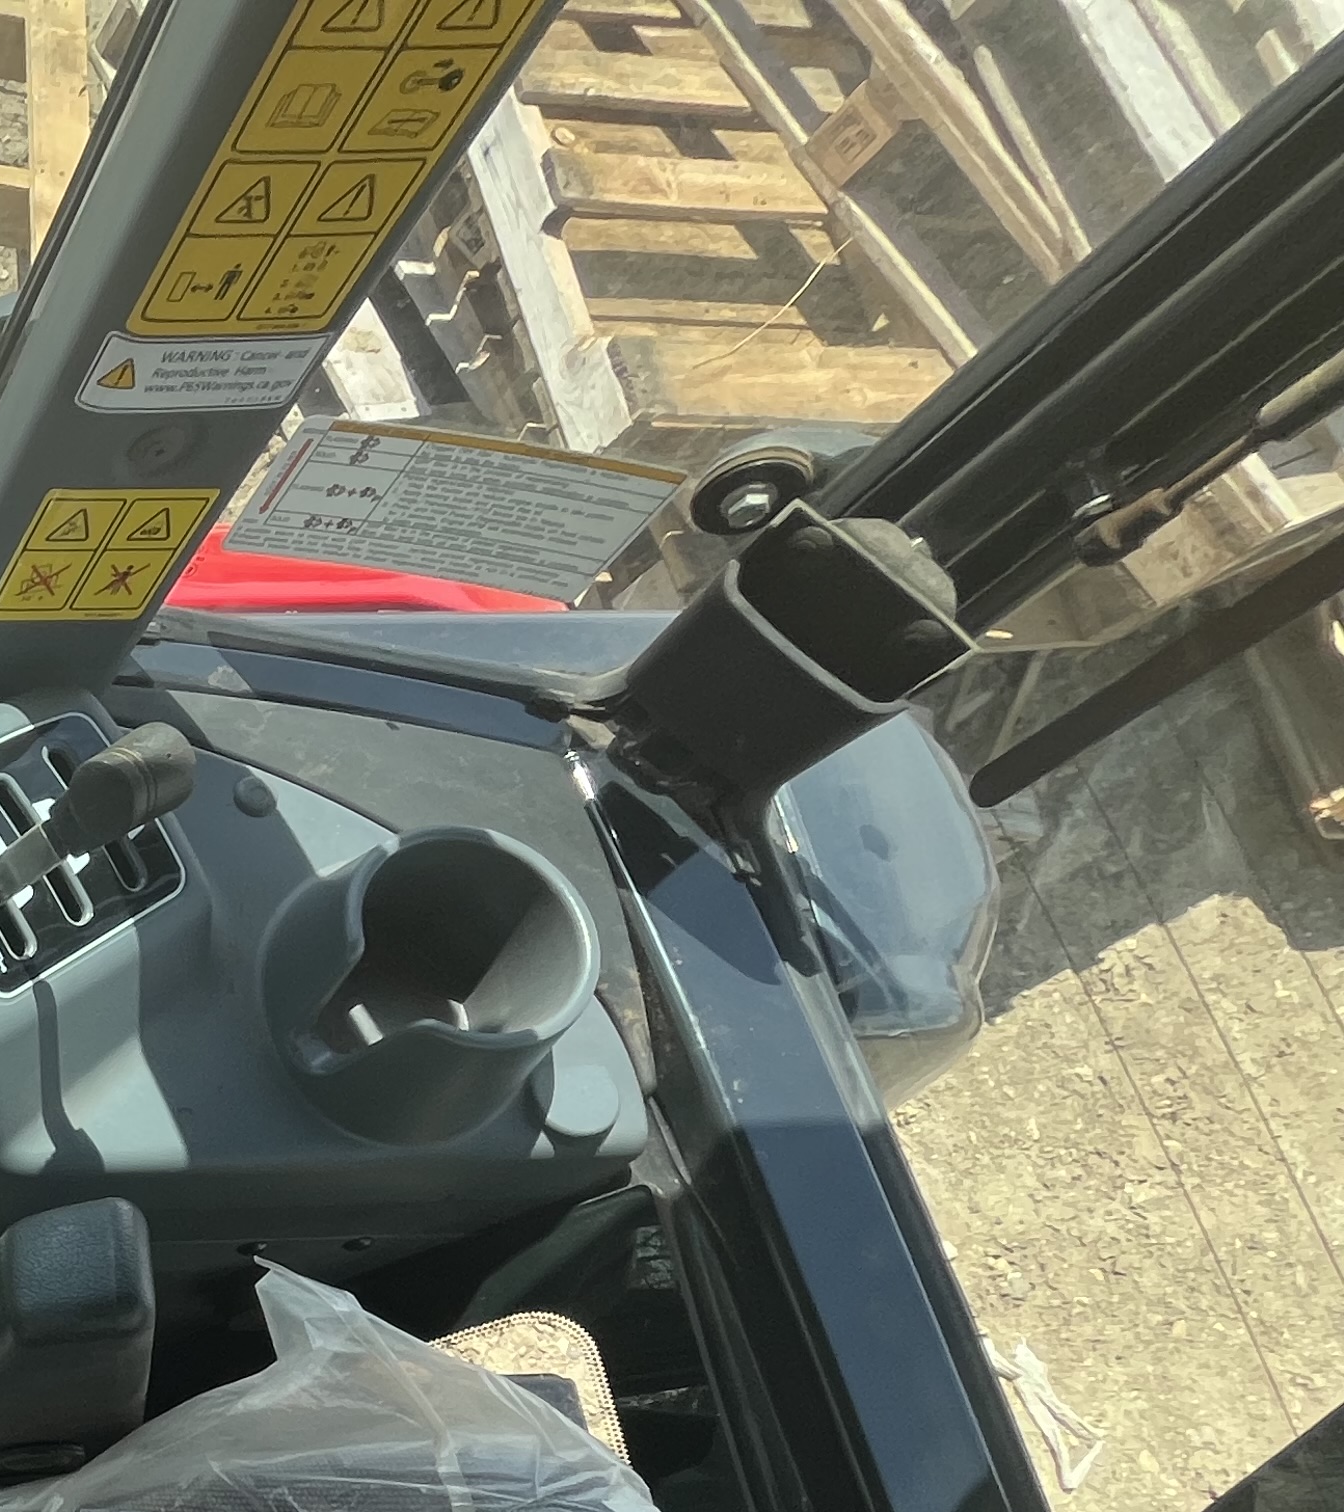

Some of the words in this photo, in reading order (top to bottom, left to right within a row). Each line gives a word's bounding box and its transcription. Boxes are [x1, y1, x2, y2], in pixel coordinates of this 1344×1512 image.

[240, 350, 281, 362] Cancer
[151, 366, 230, 380] Reproductive
[234, 365, 268, 377] Harm
